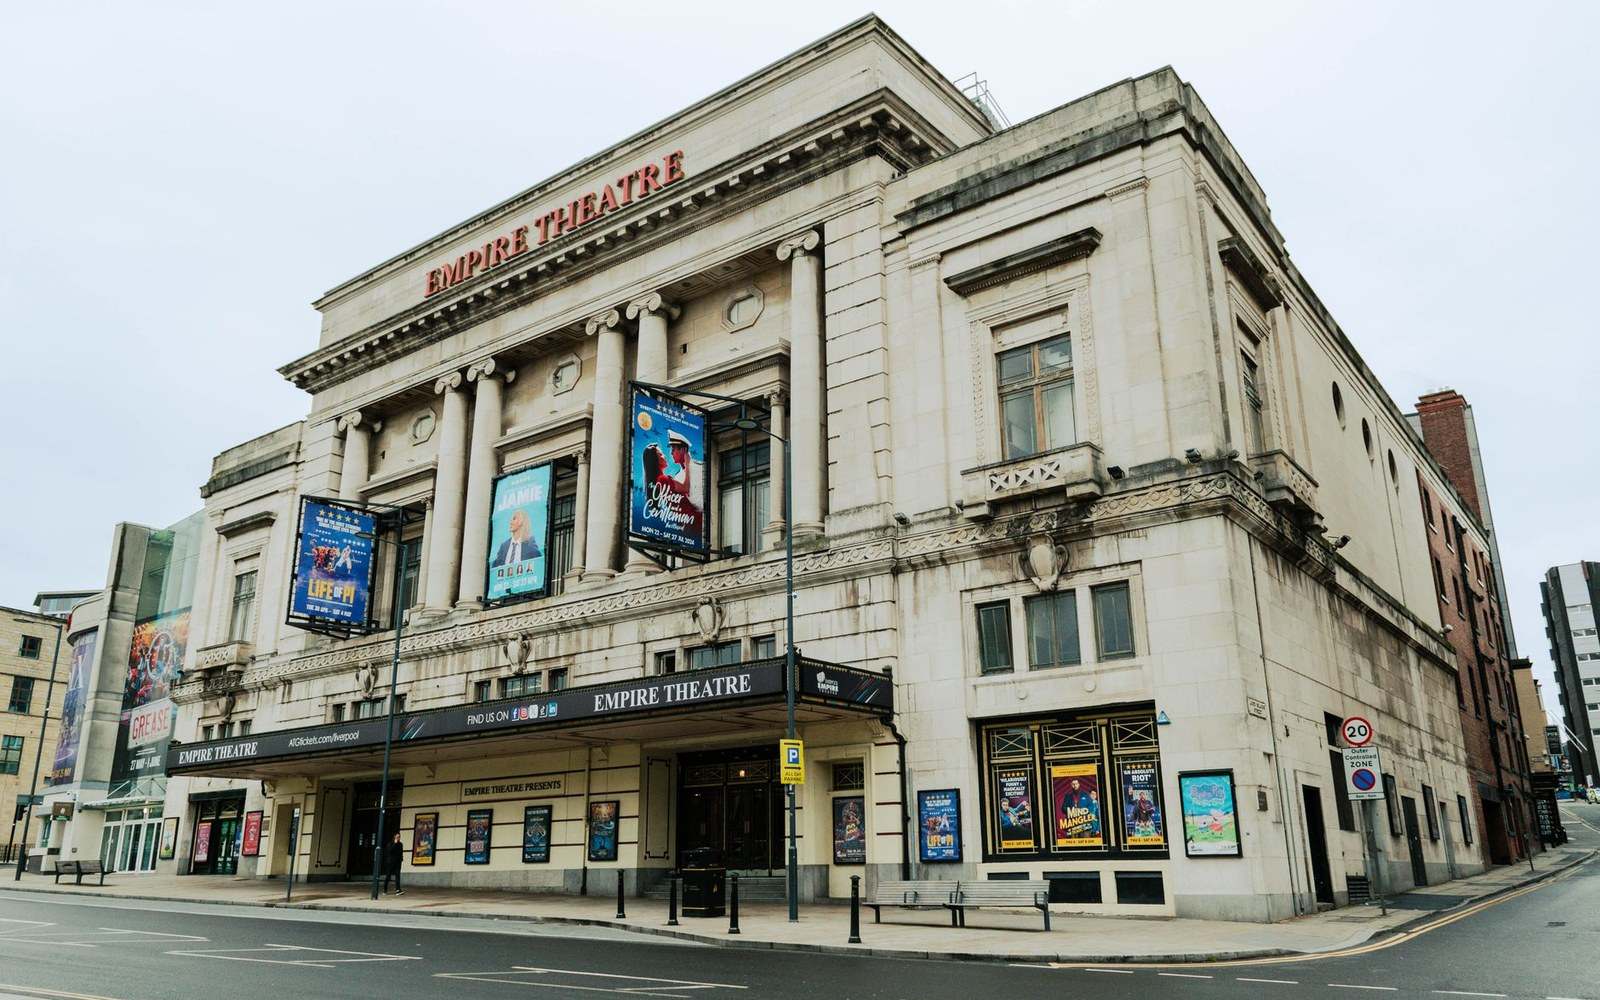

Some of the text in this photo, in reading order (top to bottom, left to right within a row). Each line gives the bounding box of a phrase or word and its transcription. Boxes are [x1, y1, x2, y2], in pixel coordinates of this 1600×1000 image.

[424, 150, 685, 298] EMPIRE THEATRE
[653, 482, 684, 507] Officer
[643, 499, 694, 524] Gentleman
[641, 526, 654, 534] MON
[308, 578, 334, 601] LIFE
[343, 583, 356, 604] PI
[593, 674, 751, 712] EMPIRE THEATRE
[132, 707, 170, 740] GREASE
[467, 709, 510, 725] FIND US ON
[288, 730, 360, 748] ATGtickets.com/liverpool
[1347, 725, 1367, 737] 20
[179, 742, 258, 764] EMPIRE THEATRE
[789, 749, 798, 762] P
[464, 780, 561, 796] EMPIRE THEATRE PRESENTS
[1067, 806, 1089, 819] MIND
